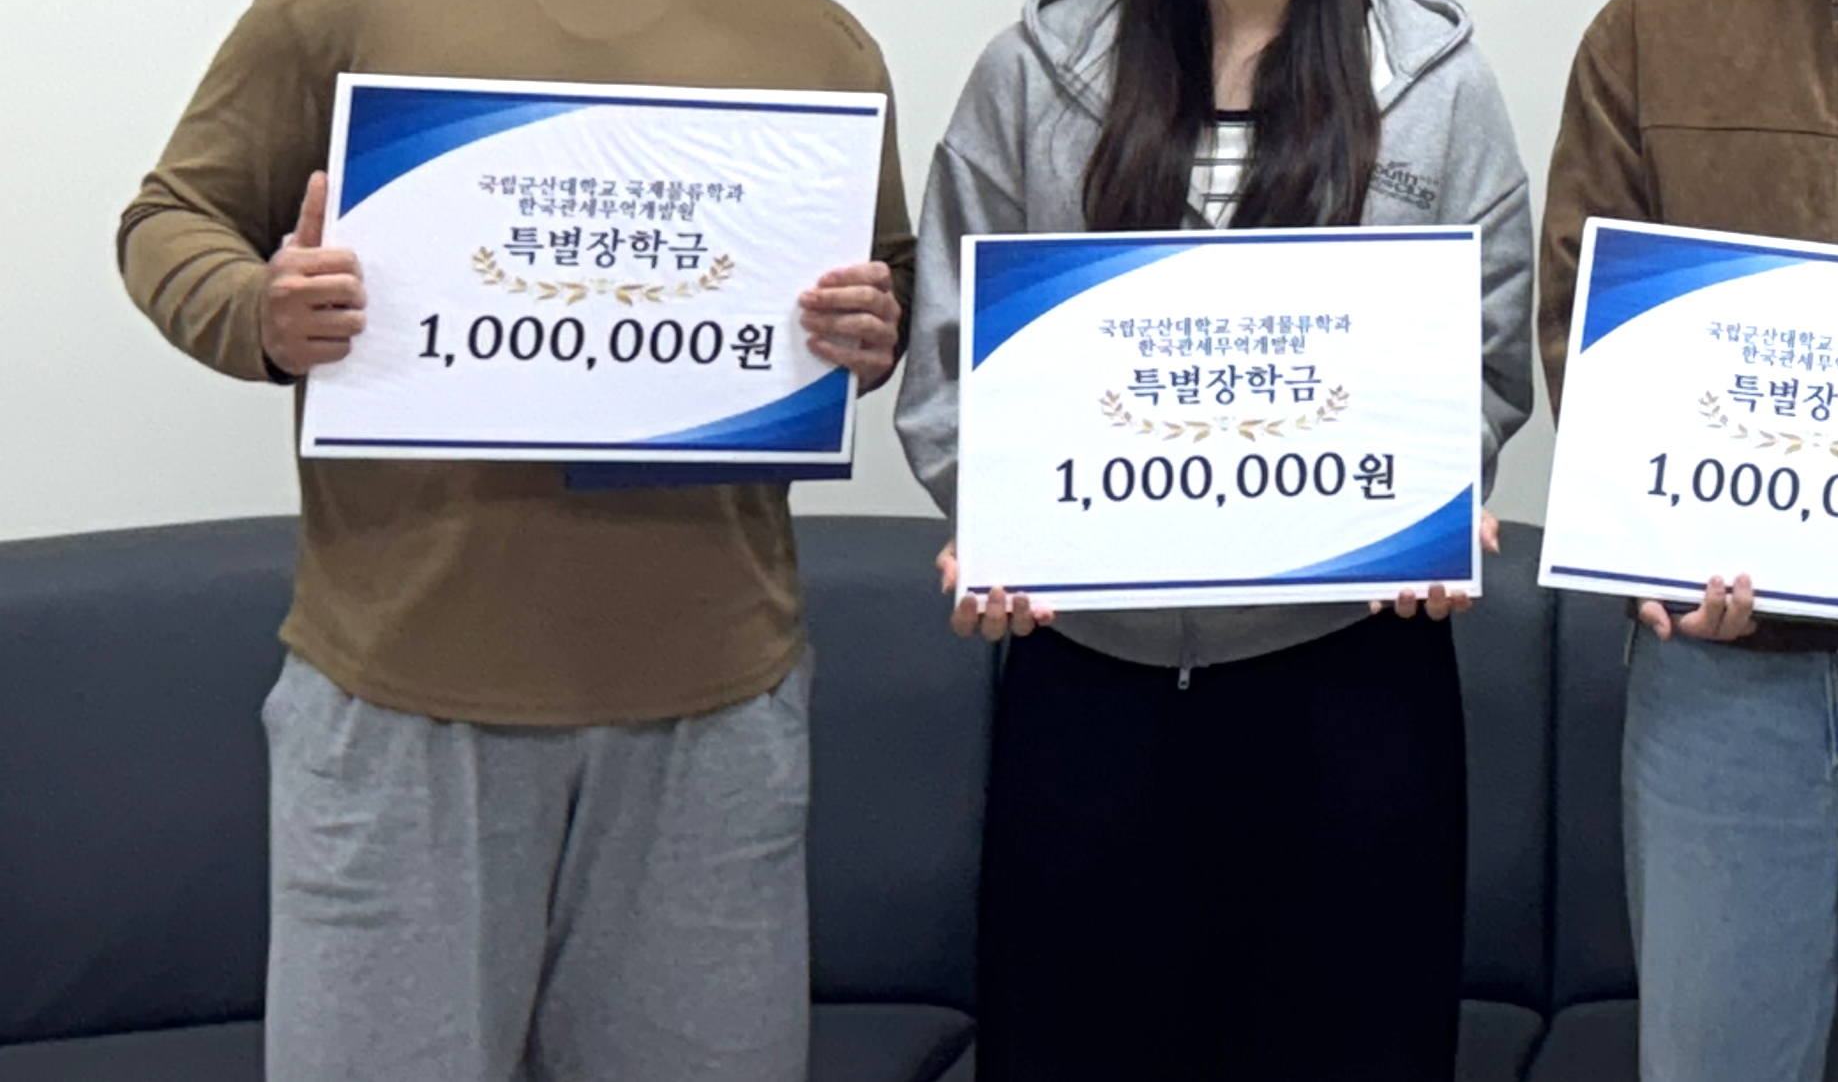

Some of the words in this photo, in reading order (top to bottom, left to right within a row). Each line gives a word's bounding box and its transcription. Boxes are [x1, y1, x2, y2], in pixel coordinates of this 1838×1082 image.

[479, 175, 618, 197] 국립군산대학교
[626, 179, 745, 202] 국제물류학과
[519, 197, 696, 222] 한국관세무역개발원
[503, 226, 708, 270] 특별장학금
[1099, 316, 1231, 338] 국립군산대학교
[1237, 313, 1351, 335] 국제물류학과
[1706, 321, 1833, 351] 국립군산대학교
[418, 314, 775, 370] 1,000,000원
[1138, 335, 1306, 357] 한국관세무역개발원
[1127, 364, 1322, 406] 특별장학금
[1056, 452, 1396, 511] 1,000,000원
